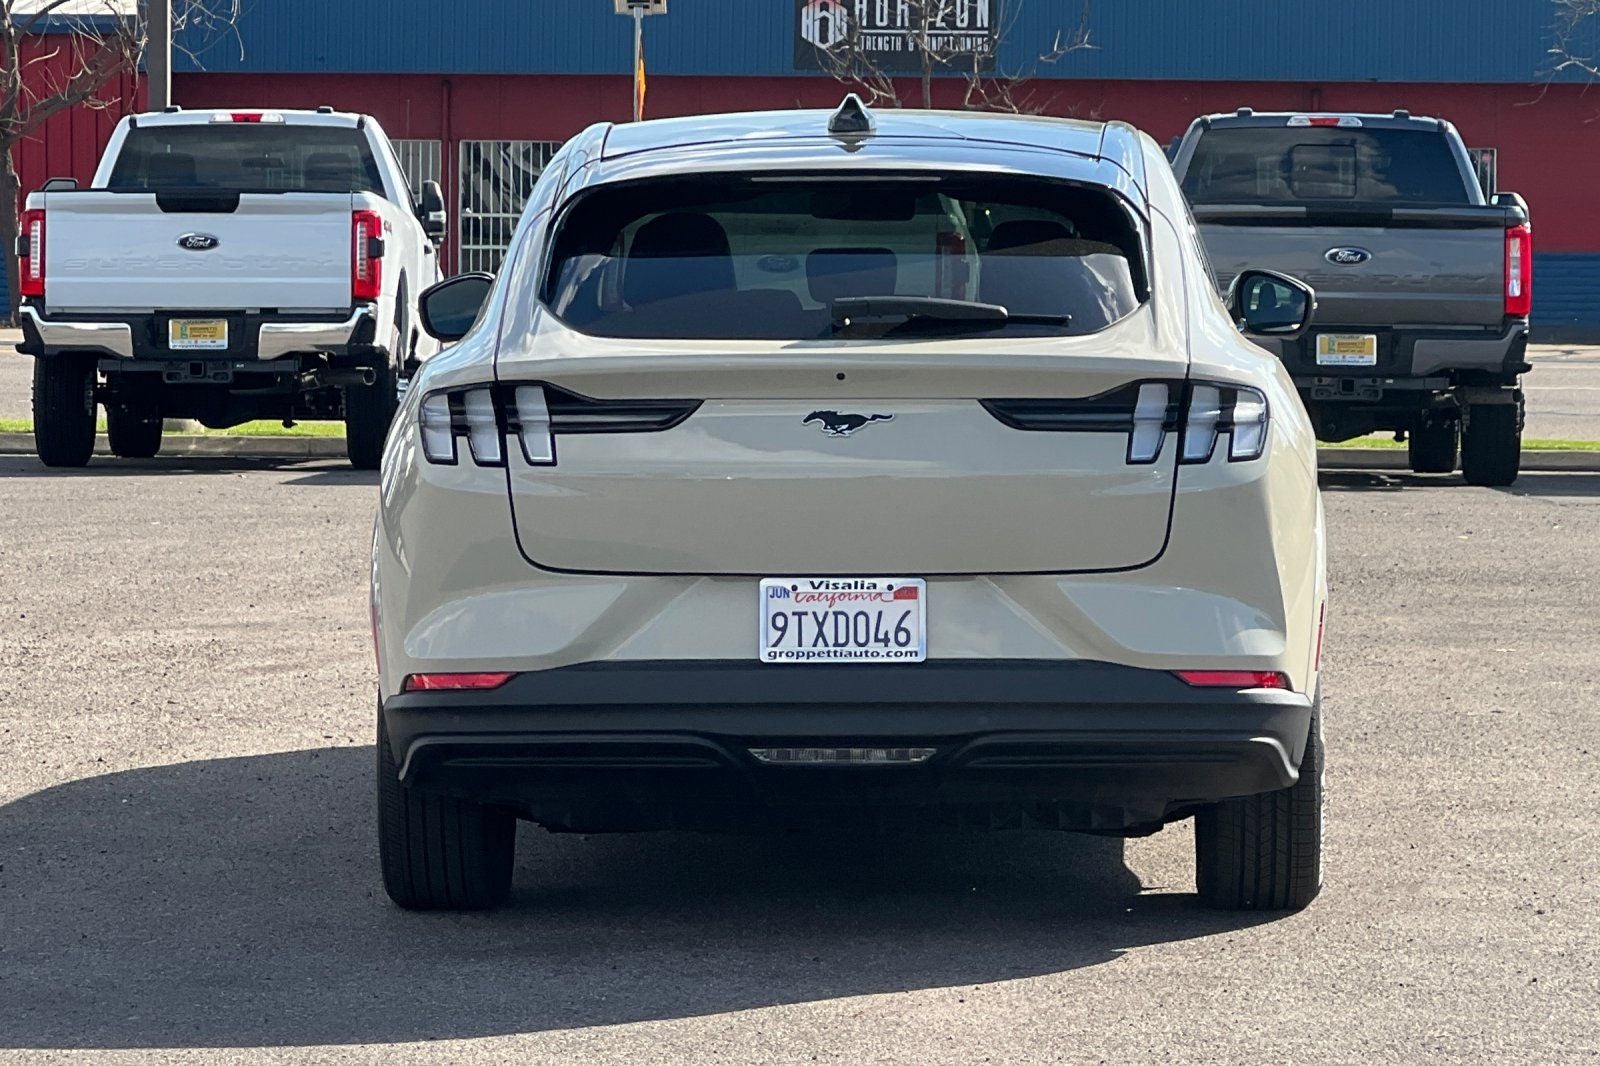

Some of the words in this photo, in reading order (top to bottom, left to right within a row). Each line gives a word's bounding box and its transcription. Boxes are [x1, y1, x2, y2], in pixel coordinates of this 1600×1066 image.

[854, 0, 989, 28] HORZON
[809, 580, 878, 591] Visalia
[769, 587, 790, 599] JUN
[794, 592, 894, 608] California
[770, 610, 912, 648] 9TXD046
[767, 649, 919, 660] groppettiauto.com
